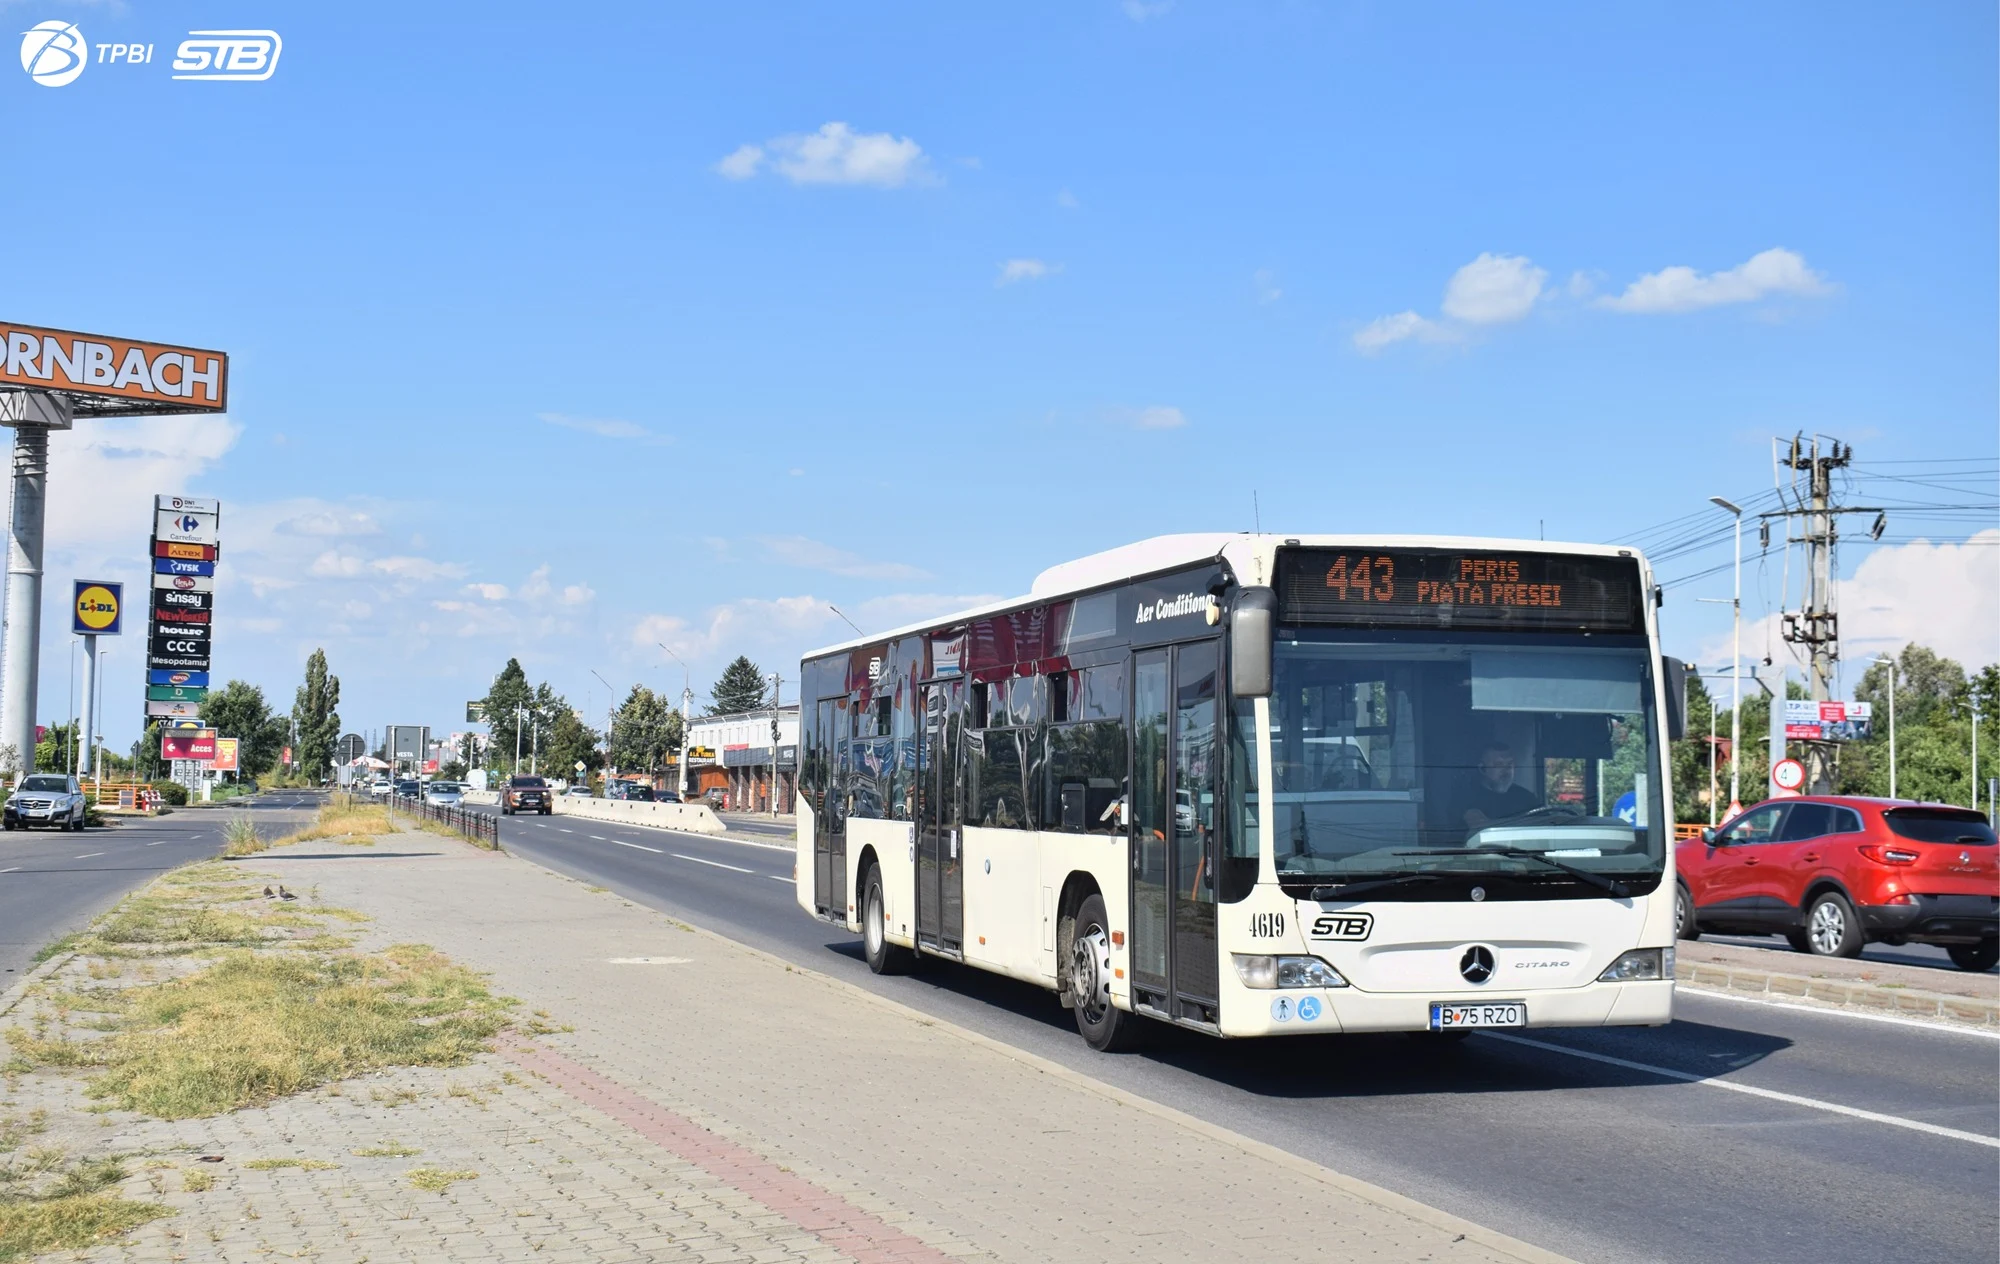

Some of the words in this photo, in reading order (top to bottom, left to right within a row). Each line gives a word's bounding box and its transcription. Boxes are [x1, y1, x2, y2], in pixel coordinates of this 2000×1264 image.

[0, 330, 220, 402] RNBACH
[170, 533, 203, 542] Carrefour
[176, 562, 200, 573] JYSK
[1460, 559, 1520, 582] PERIS
[1326, 555, 1394, 601] 443
[165, 591, 202, 607] sinsay
[1417, 581, 1485, 604] PIATA
[1491, 583, 1562, 606] PRESEI
[79, 598, 116, 613] LIDL
[1136, 603, 1154, 624] Aer
[166, 640, 196, 653] CCC
[152, 656, 208, 666] Mesopotamia
[190, 744, 213, 753] Acces
[1248, 912, 1285, 938] 4619
[1311, 917, 1368, 936] STB
[1460, 1008, 1478, 1025] 75
[1483, 1007, 1517, 1024] RZO
